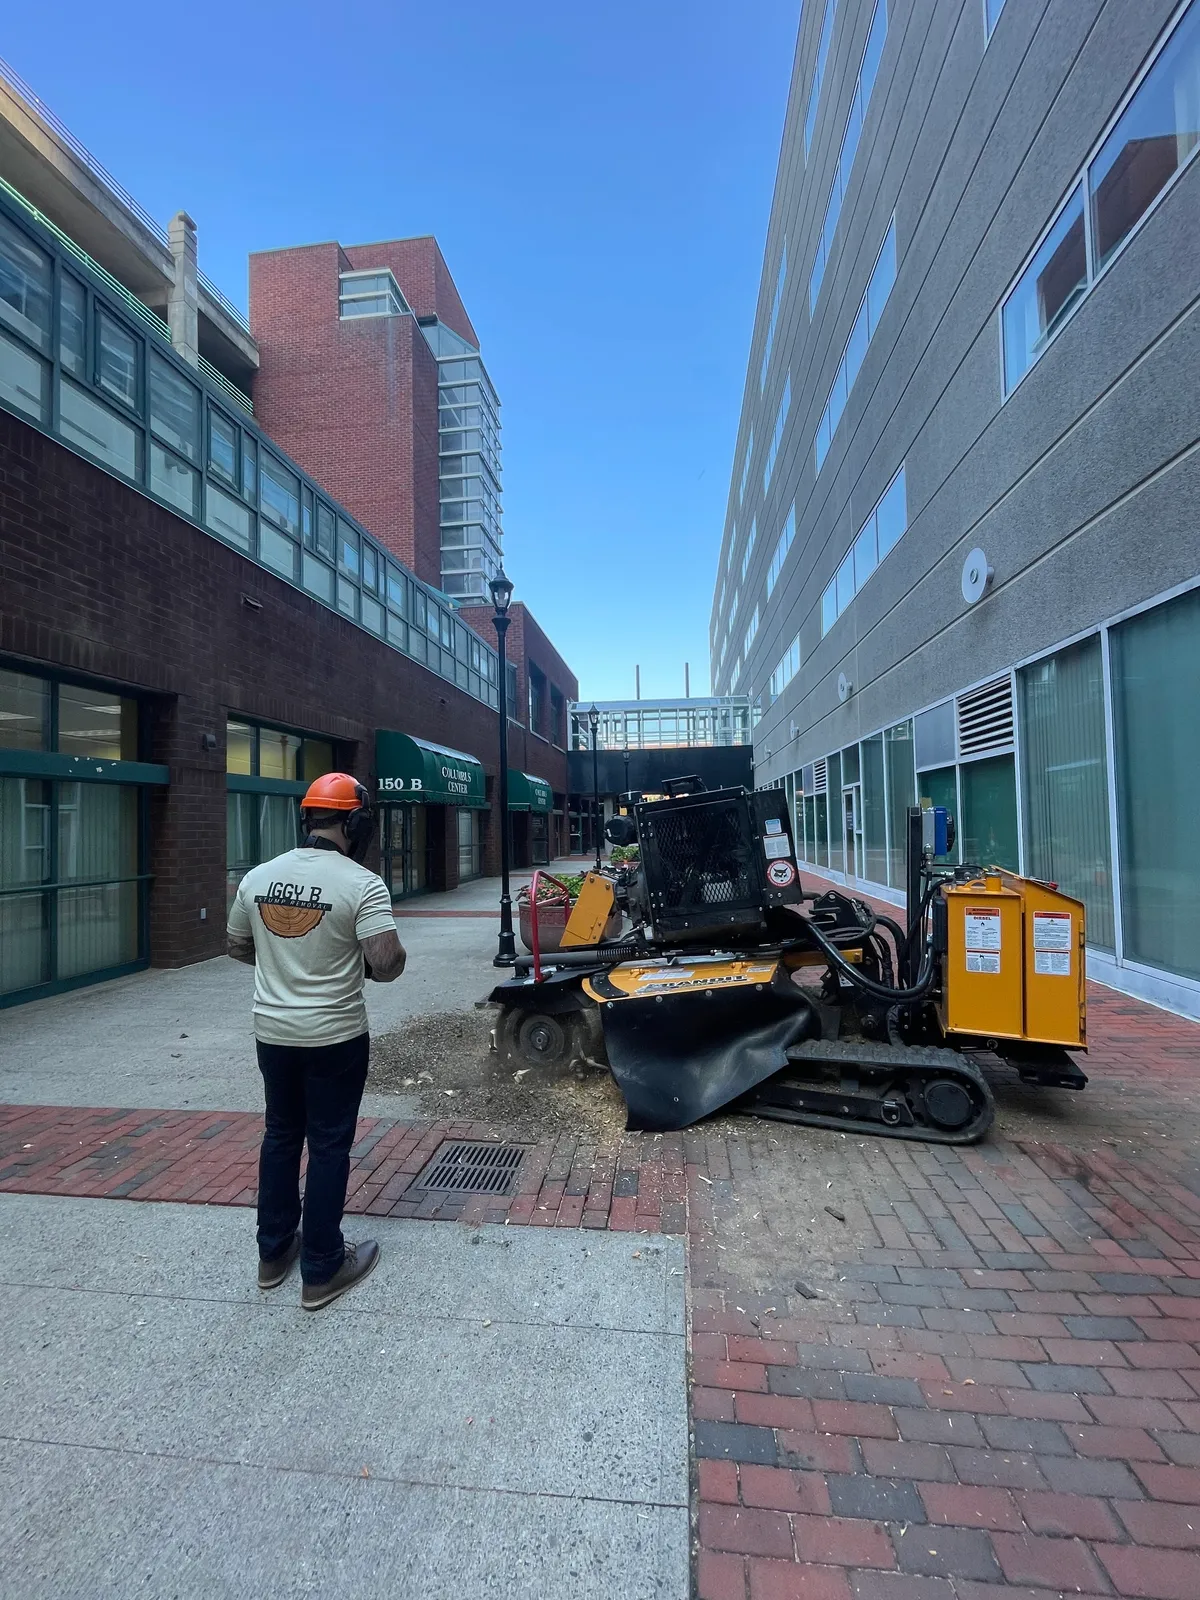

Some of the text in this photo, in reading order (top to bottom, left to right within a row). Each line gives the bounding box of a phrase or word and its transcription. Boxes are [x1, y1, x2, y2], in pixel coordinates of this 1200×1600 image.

[441, 766, 472, 783] COLUMBUS
[378, 778, 423, 791] 150 B
[447, 780, 469, 794] CENTER
[267, 881, 322, 902] IGGY B
[289, 900, 328, 910] REMOVAL
